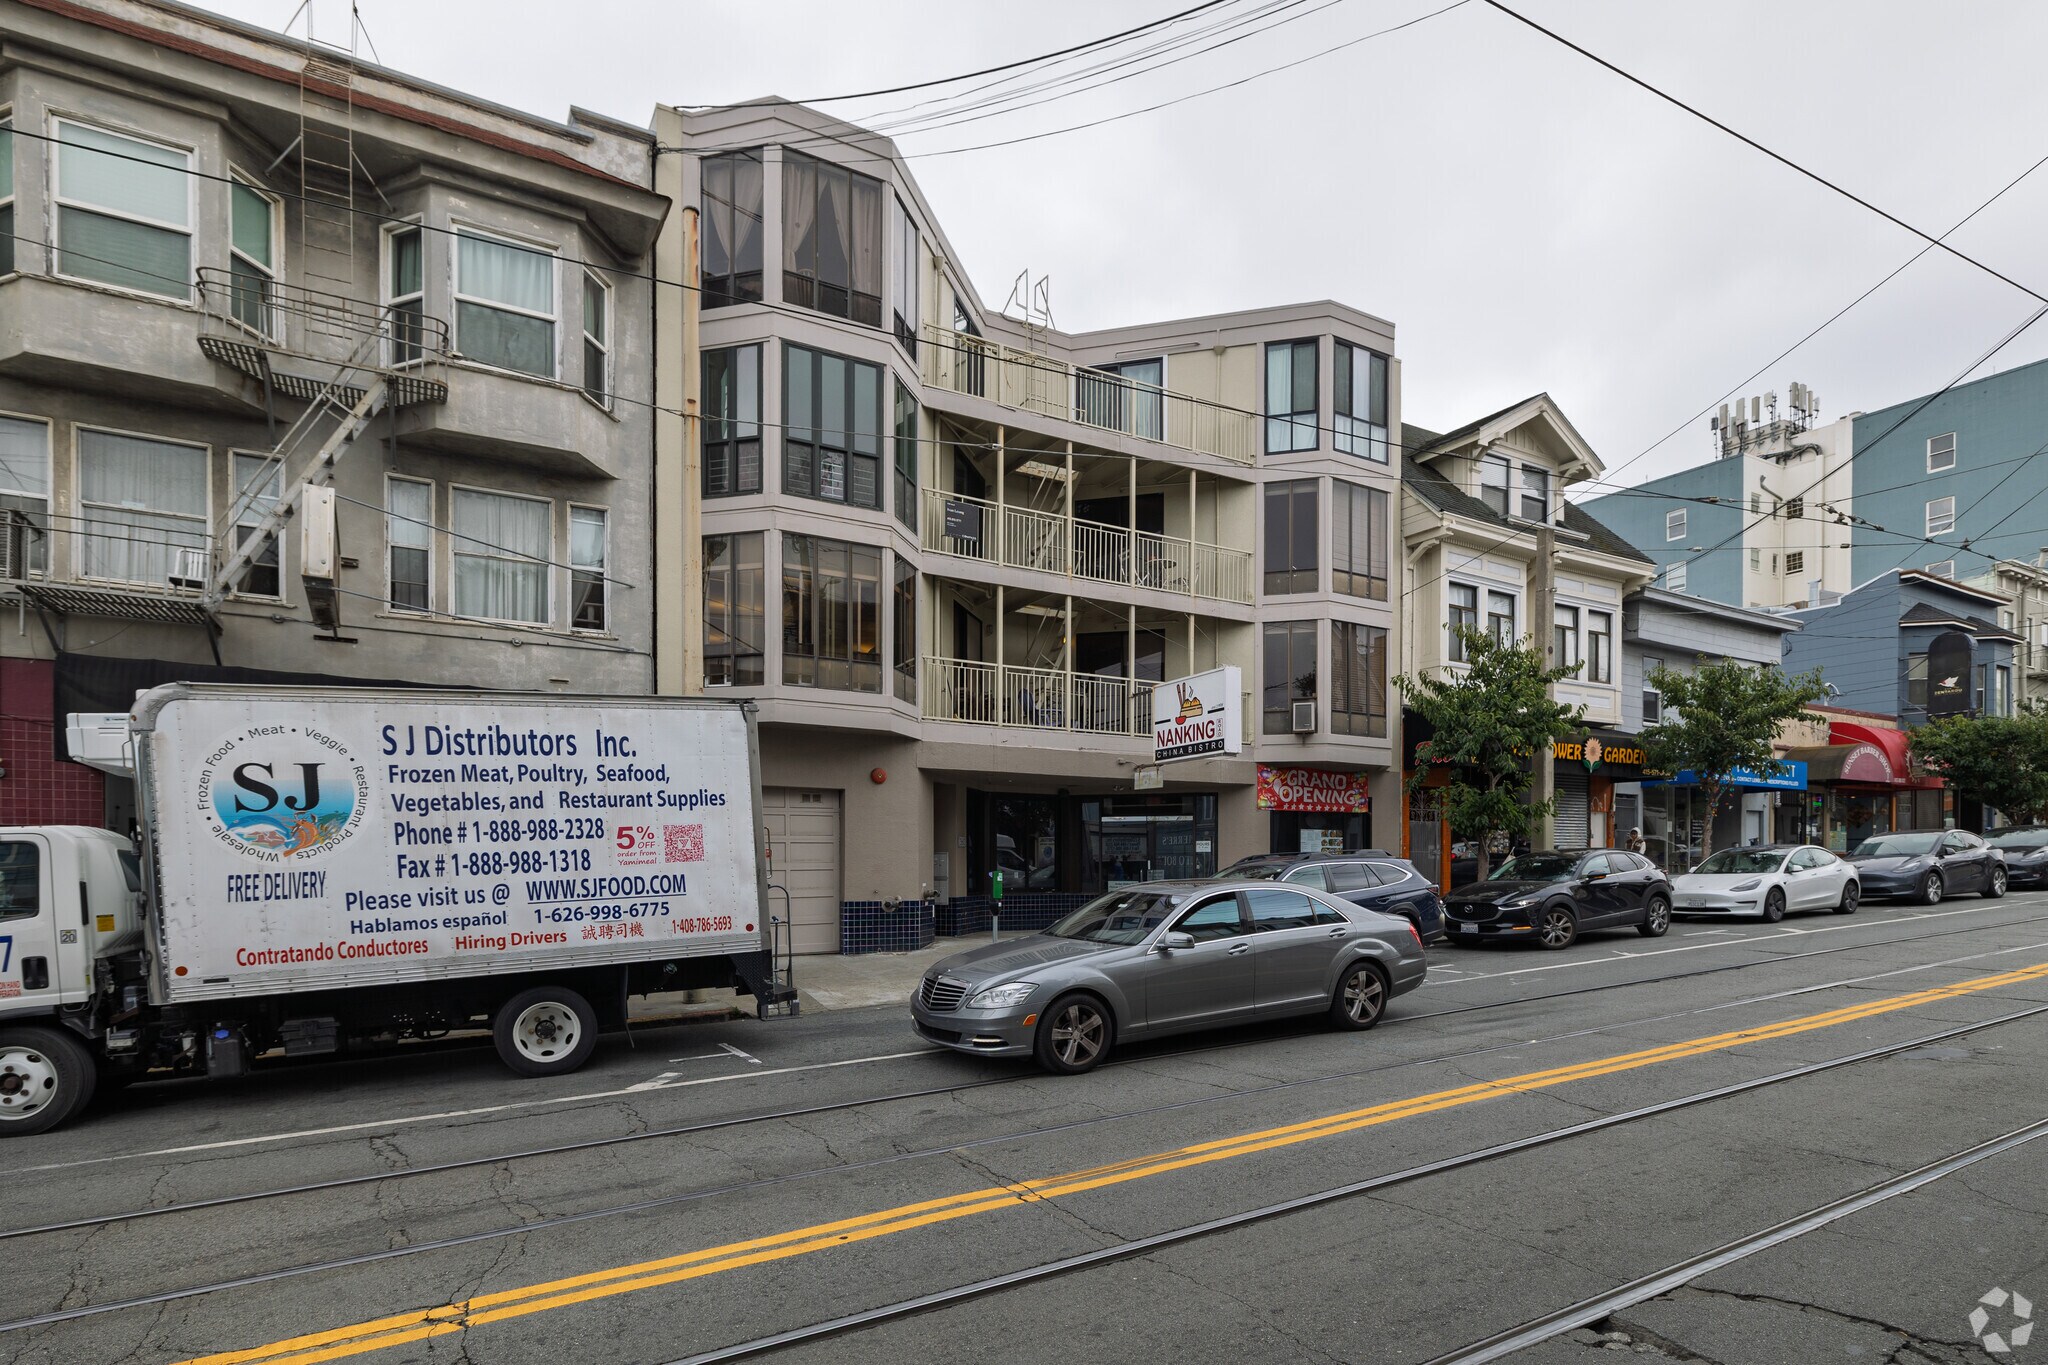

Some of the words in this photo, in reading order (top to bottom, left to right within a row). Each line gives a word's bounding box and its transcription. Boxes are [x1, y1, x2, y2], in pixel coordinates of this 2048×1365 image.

[247, 724, 285, 739] Meat
[305, 727, 348, 756] Veggie
[382, 725, 397, 756] S
[405, 725, 415, 756] J
[425, 725, 577, 756] Distributors
[596, 729, 637, 757] Inc.
[1157, 720, 1215, 748] NANKING
[1157, 747, 1184, 758] CHINA
[1188, 740, 1224, 753] BISTRO
[1551, 742, 1582, 760] OWER
[1604, 746, 1647, 765] GARDEN
[1844, 748, 1861, 774] SUNSET
[1860, 746, 1879, 759] BARBER
[1879, 755, 1891, 774] SHOP
[197, 769, 212, 811] Frozen
[205, 740, 235, 767] Food
[233, 762, 326, 813] SJ
[388, 764, 456, 783] Frozen
[461, 764, 513, 785] Meat,
[517, 763, 588, 787] Poultry,
[596, 763, 670, 784] Seafood,
[1287, 769, 1347, 790] GRAND
[353, 765, 370, 829] Restaurant
[391, 791, 505, 817] Vegetables,
[509, 790, 544, 810] and
[559, 791, 653, 809] Restaurant
[657, 789, 726, 811] Supplies
[1280, 785, 1356, 805] OPENING
[212, 825, 280, 863] Wholesale
[296, 828, 354, 860] Products
[394, 821, 453, 845] Phone
[457, 822, 467, 843] #
[472, 818, 605, 842] 1-888-988-2328
[616, 826, 655, 849] 5%
[638, 841, 656, 849] OFF
[397, 854, 430, 878] Fax
[435, 854, 446, 877] #
[451, 849, 591, 876] 1-888-988-1318
[618, 857, 657, 866] Yamimeal
[227, 874, 259, 902] FREE
[264, 870, 326, 901] DELIVERY
[345, 890, 412, 911] Please
[417, 887, 459, 907] visit
[464, 889, 486, 904] us
[492, 883, 511, 905] @
[526, 874, 687, 902] WWW.SJFOOD.COM
[350, 917, 438, 935] Hablamos
[442, 911, 507, 930] español
[534, 902, 670, 923] 1-626-998-6775
[672, 916, 733, 934] 1-408-786-5693
[62, 934, 75, 942] 20
[455, 934, 507, 950] Hiring
[511, 931, 567, 946] Drivers
[580, 921, 645, 941] 誠聘司機
[236, 942, 334, 966] Contratando
[337, 939, 428, 959] Conductores
